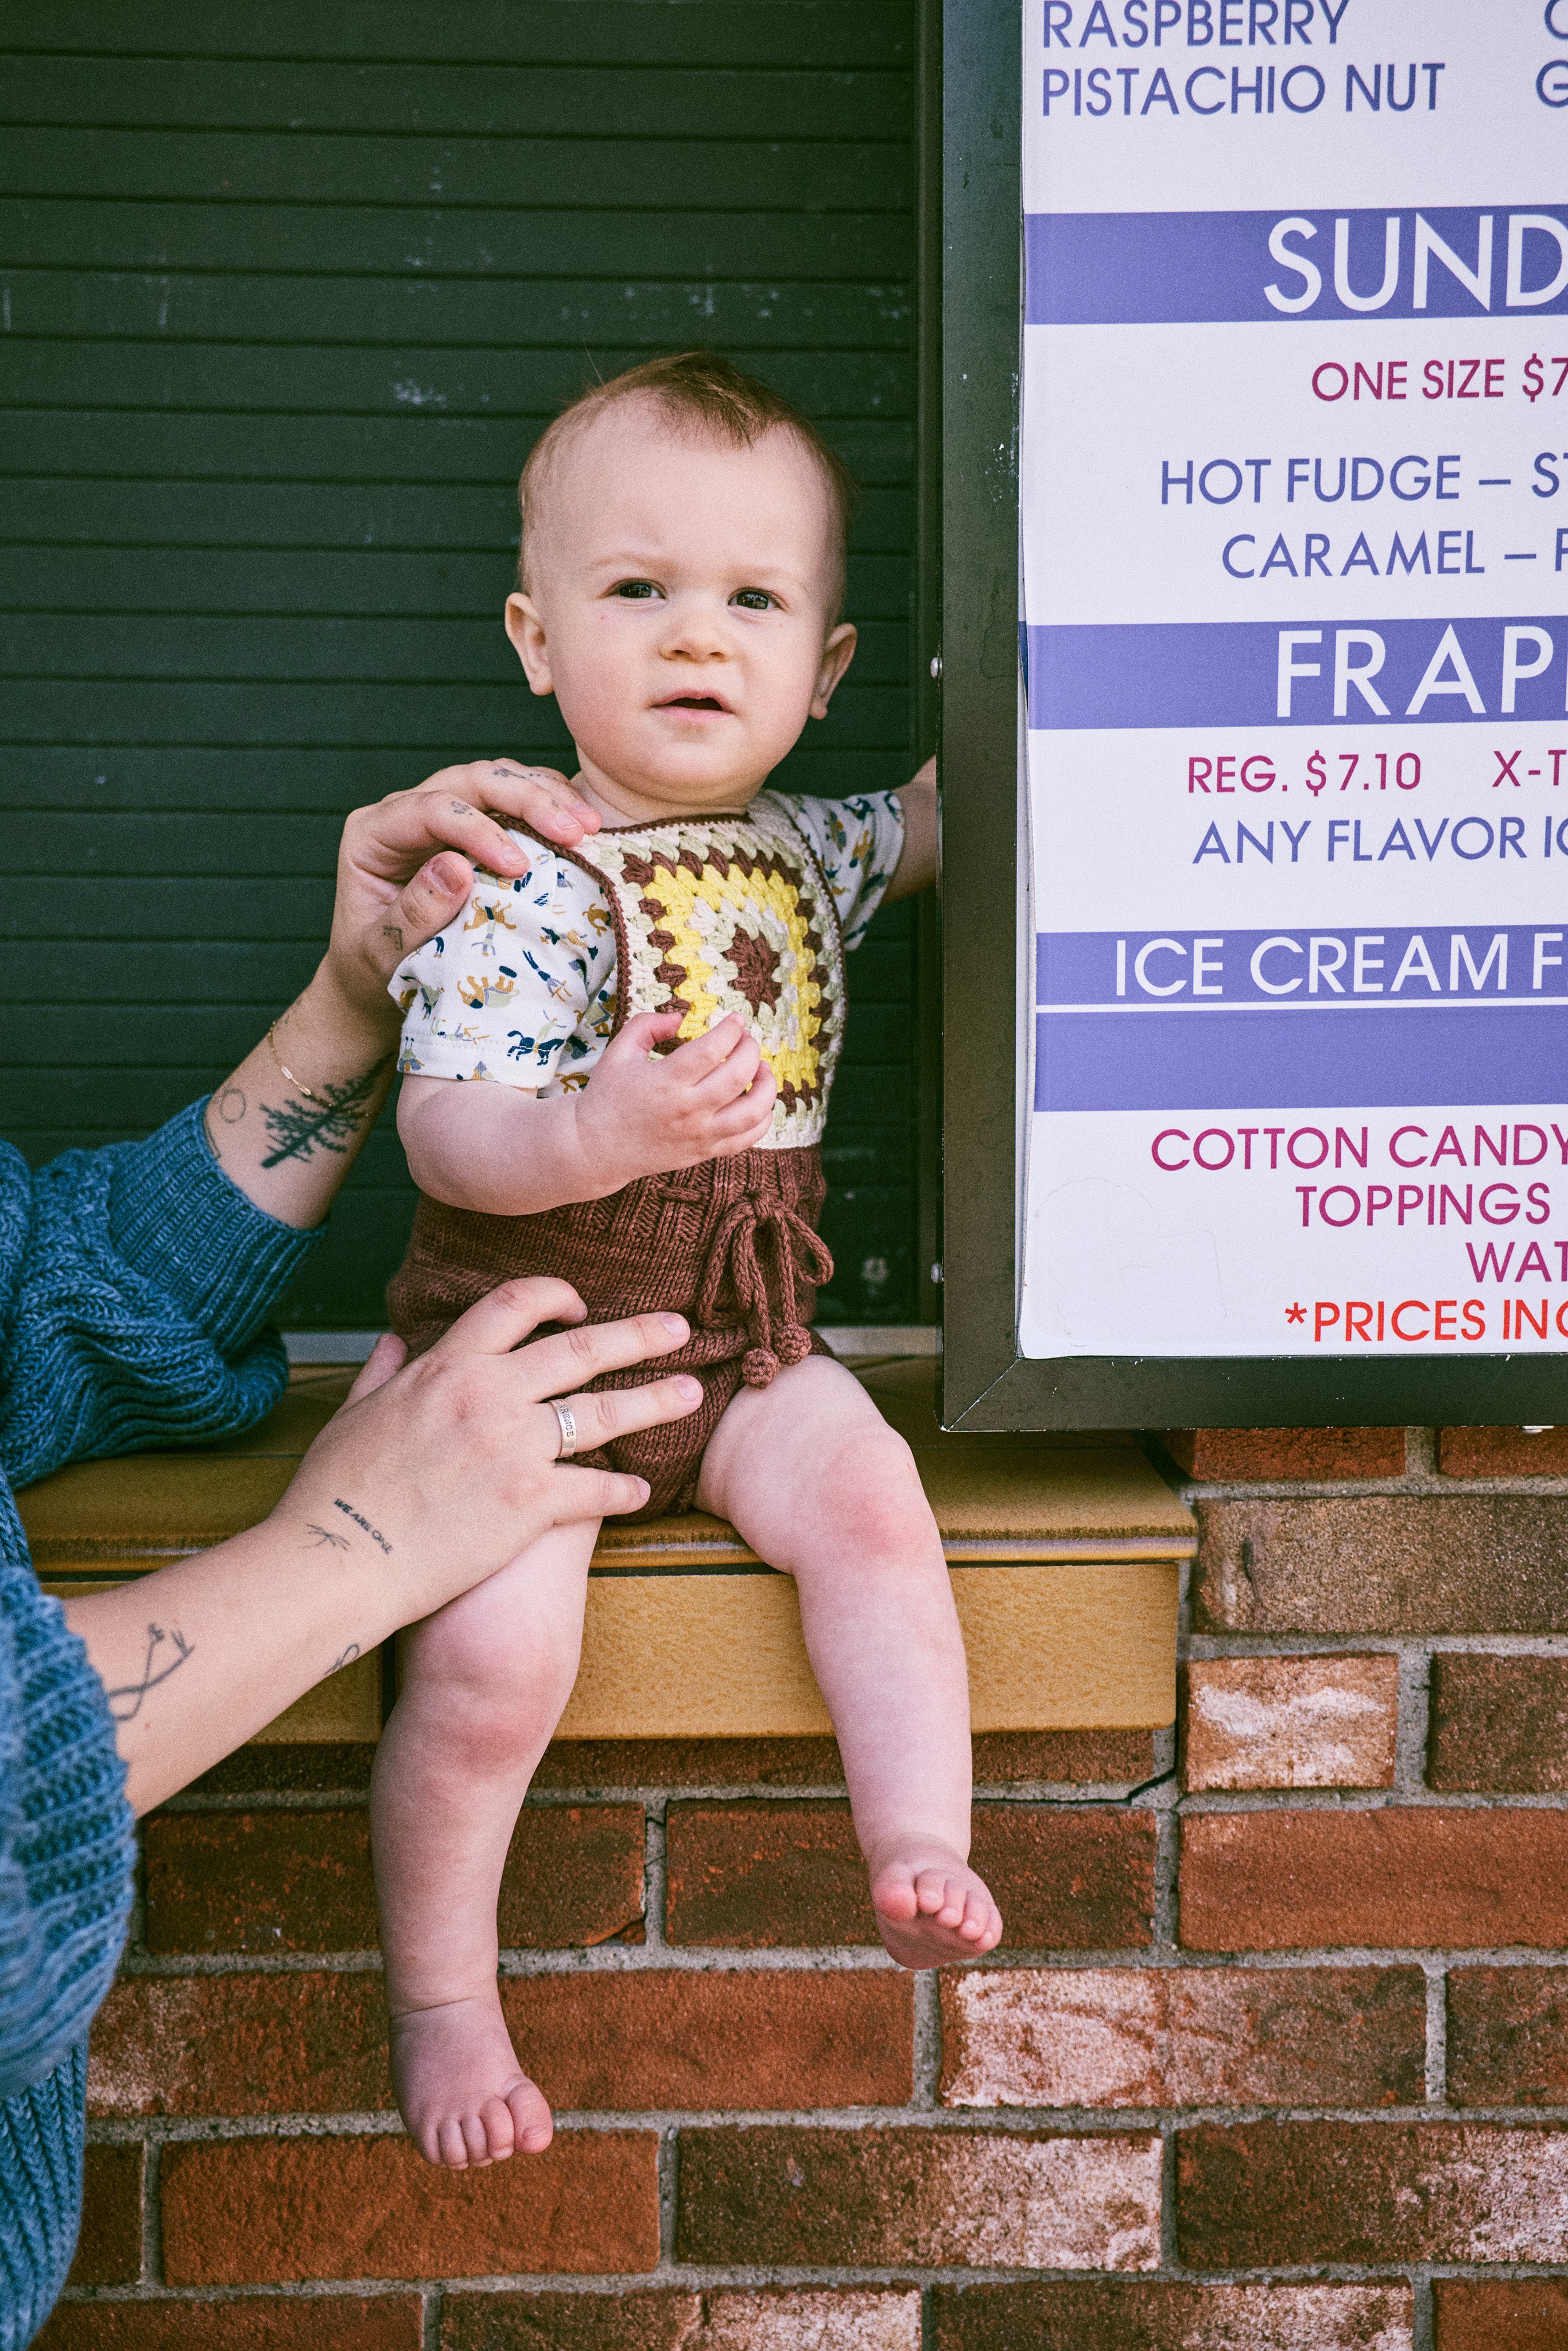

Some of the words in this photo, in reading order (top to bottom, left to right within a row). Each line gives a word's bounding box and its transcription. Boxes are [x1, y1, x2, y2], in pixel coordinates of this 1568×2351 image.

[1043, 0, 1349, 48] RASPBERRY
[1043, 64, 1326, 117] PISTACHIO
[1346, 63, 1446, 112] NUT
[1263, 213, 1568, 314] SUND
[1311, 360, 1408, 401] ONE
[1422, 358, 1505, 399] SIZE
[1161, 459, 1272, 505] HOT
[1287, 455, 1461, 503] FUDGE
[1531, 452, 1568, 498] S
[1222, 530, 1485, 579] CARAMEL
[1277, 623, 1568, 718] FRAP
[1188, 755, 1288, 793] REG.
[1305, 750, 1422, 797] $7.10
[1492, 748, 1567, 787] X-T
[1192, 820, 1311, 864] ANY
[1328, 816, 1527, 862] FLAVOR
[1116, 938, 1224, 996] ICE
[1250, 933, 1508, 995] CREAM
[1151, 1126, 1368, 1171] COTTON
[1389, 1123, 1568, 1168] CANDY
[1295, 1182, 1550, 1227] TOPPINGS
